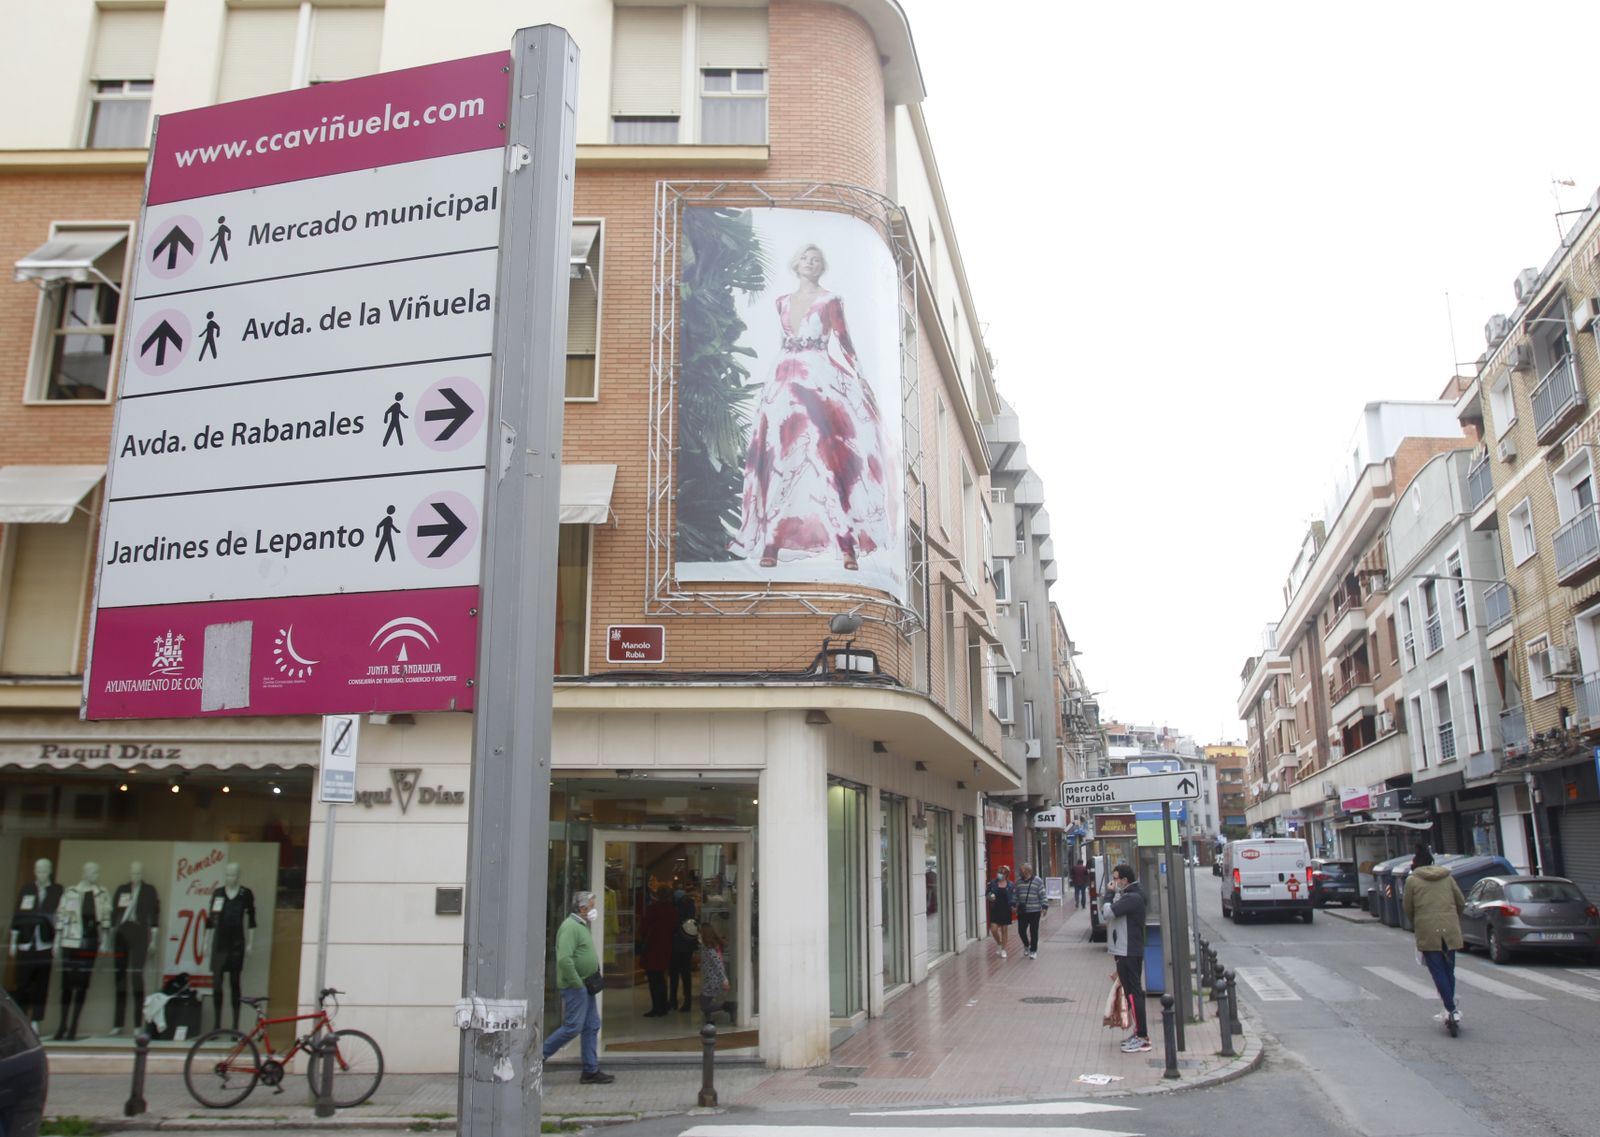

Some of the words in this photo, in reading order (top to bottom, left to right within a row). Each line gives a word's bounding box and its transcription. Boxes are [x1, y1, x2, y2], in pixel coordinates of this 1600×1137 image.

[174, 97, 485, 168] www.ccaviñuela.com
[248, 210, 357, 246] Mercado
[365, 186, 498, 229] municipal
[242, 312, 312, 341] Avda.
[319, 306, 351, 330] de
[359, 302, 381, 327] la
[389, 288, 491, 322] Viñuela
[120, 430, 187, 458] Avda.
[194, 425, 224, 450] de
[231, 411, 365, 445] Rabanales
[107, 536, 209, 565] Jardines
[216, 531, 248, 556] de
[255, 524, 365, 558] Lepanto
[621, 641, 651, 649] Manolo
[366, 665, 389, 676] JUNTA
[391, 664, 401, 675] DE
[104, 678, 170, 692] AYUNTAMIENTO
[171, 678, 182, 691] DE
[184, 677, 203, 691] COR
[40, 744, 111, 762] Paqui
[118, 743, 183, 760] Díaz
[356, 787, 392, 808] qui
[418, 785, 465, 805] Díaz
[1065, 783, 1109, 794] mercado
[1066, 792, 1115, 804] Marrubial
[1037, 814, 1056, 822] SAT
